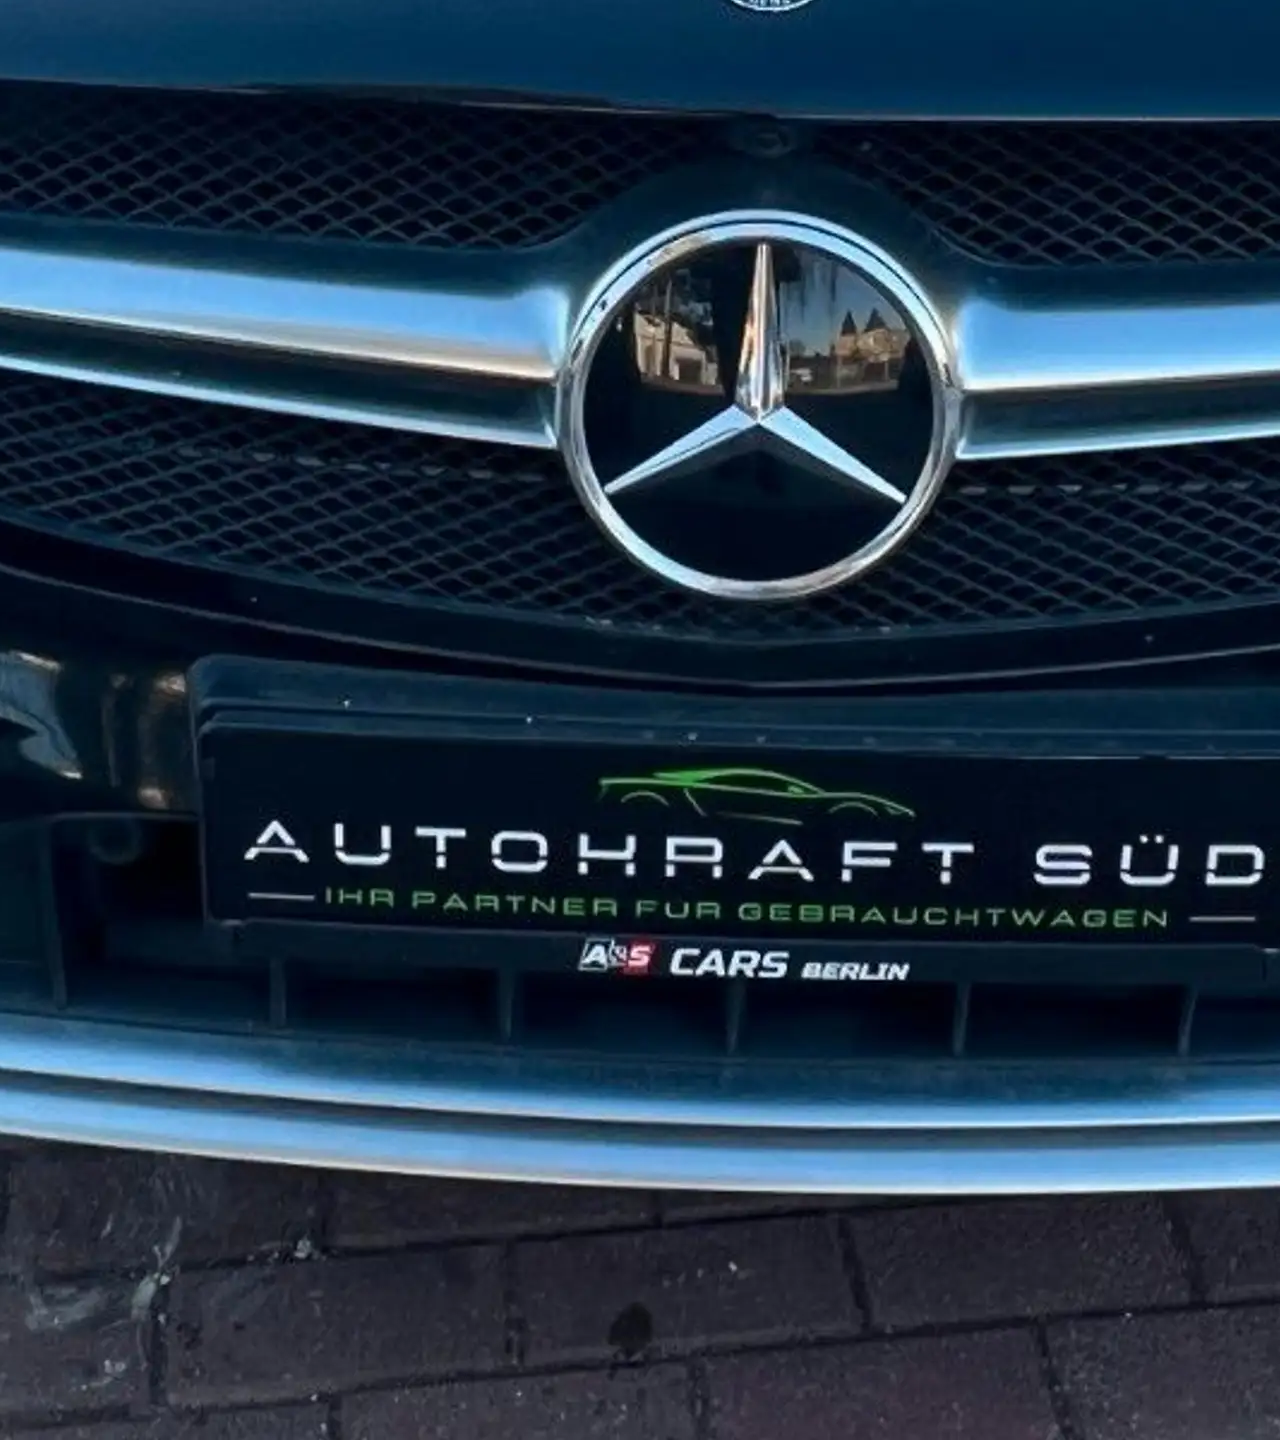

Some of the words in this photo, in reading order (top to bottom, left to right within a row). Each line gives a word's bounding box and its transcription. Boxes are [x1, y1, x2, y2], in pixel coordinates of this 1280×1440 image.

[1033, 834, 1265, 887] SÜD
[325, 886, 395, 908] IHR
[412, 889, 619, 917] PARTNER
[737, 902, 1169, 929] GEBRAUCHTWAGEN
[670, 947, 791, 978] CARS
[800, 961, 910, 981] BERLIN
